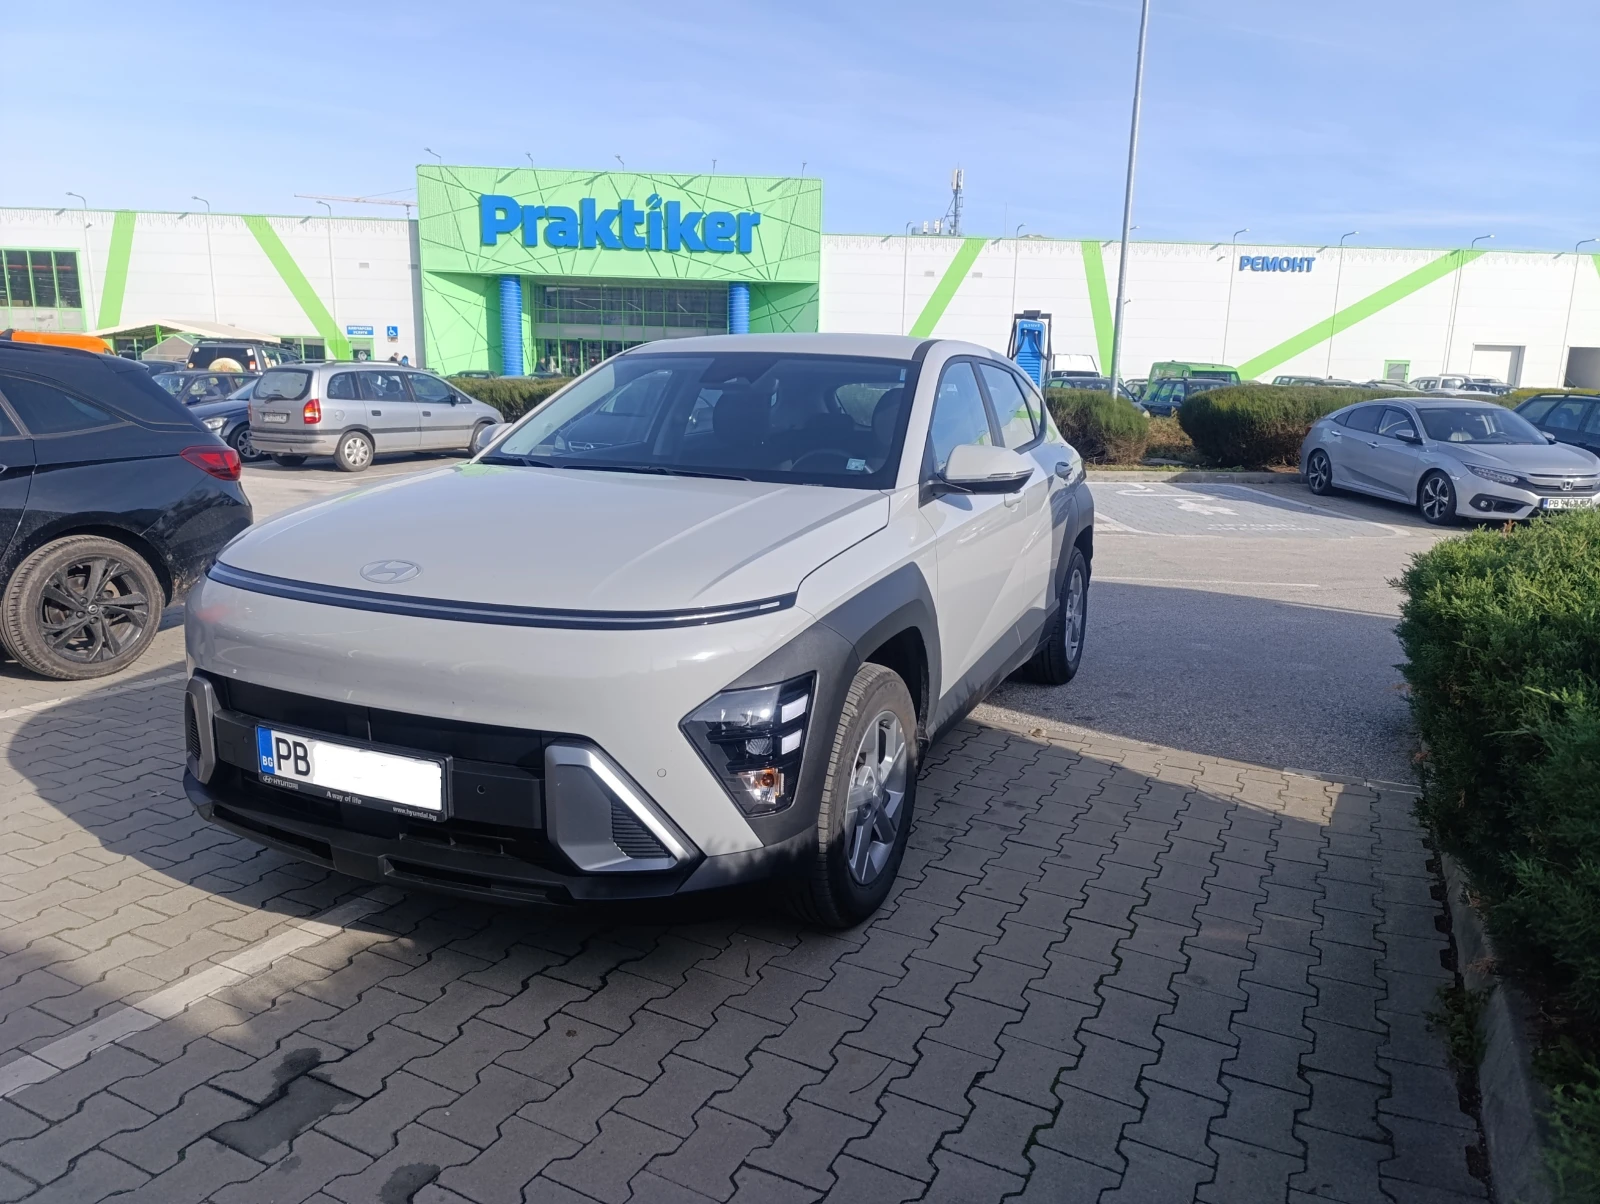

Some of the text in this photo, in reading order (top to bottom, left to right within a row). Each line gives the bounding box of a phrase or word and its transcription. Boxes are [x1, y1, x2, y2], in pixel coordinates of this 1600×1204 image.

[480, 193, 761, 254] Praktiker
[1239, 255, 1316, 273] РЕМОНТ
[262, 755, 274, 768] BG
[274, 736, 311, 777] PB
[273, 778, 299, 790] HYUNDAI
[326, 790, 362, 805] A way of life
[392, 806, 438, 822] www.hyundai.bg
